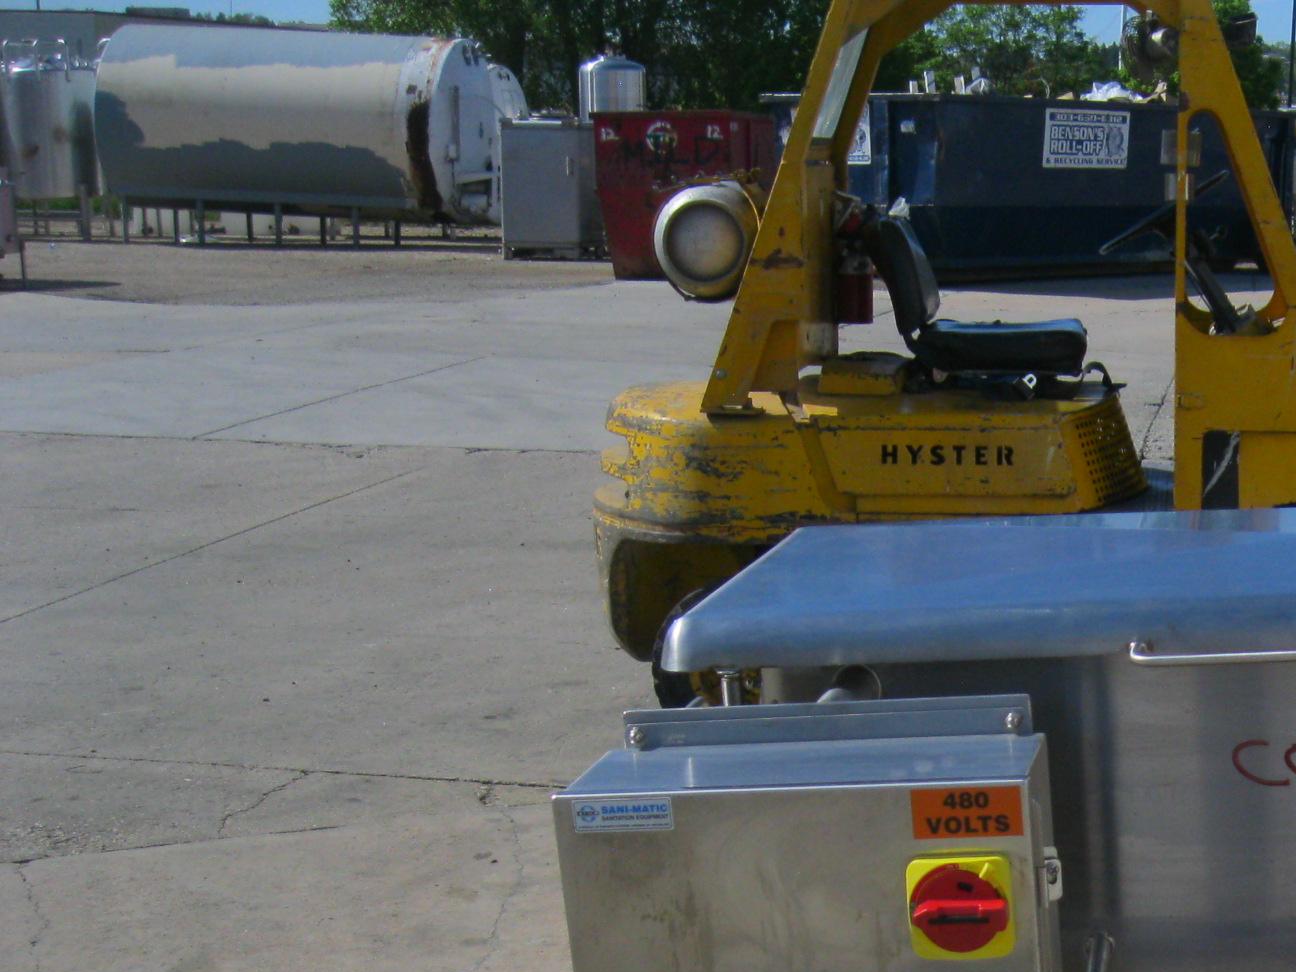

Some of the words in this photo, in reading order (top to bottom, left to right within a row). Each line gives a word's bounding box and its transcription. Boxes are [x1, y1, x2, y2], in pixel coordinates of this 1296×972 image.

[1051, 125, 1105, 141] BENSON'S
[1050, 140, 1103, 155] ROLL-OFF
[881, 444, 1015, 466] HYSTER
[601, 803, 668, 814] SANI-MATIC
[942, 791, 989, 810] 480
[926, 814, 1011, 833] VOLTS
